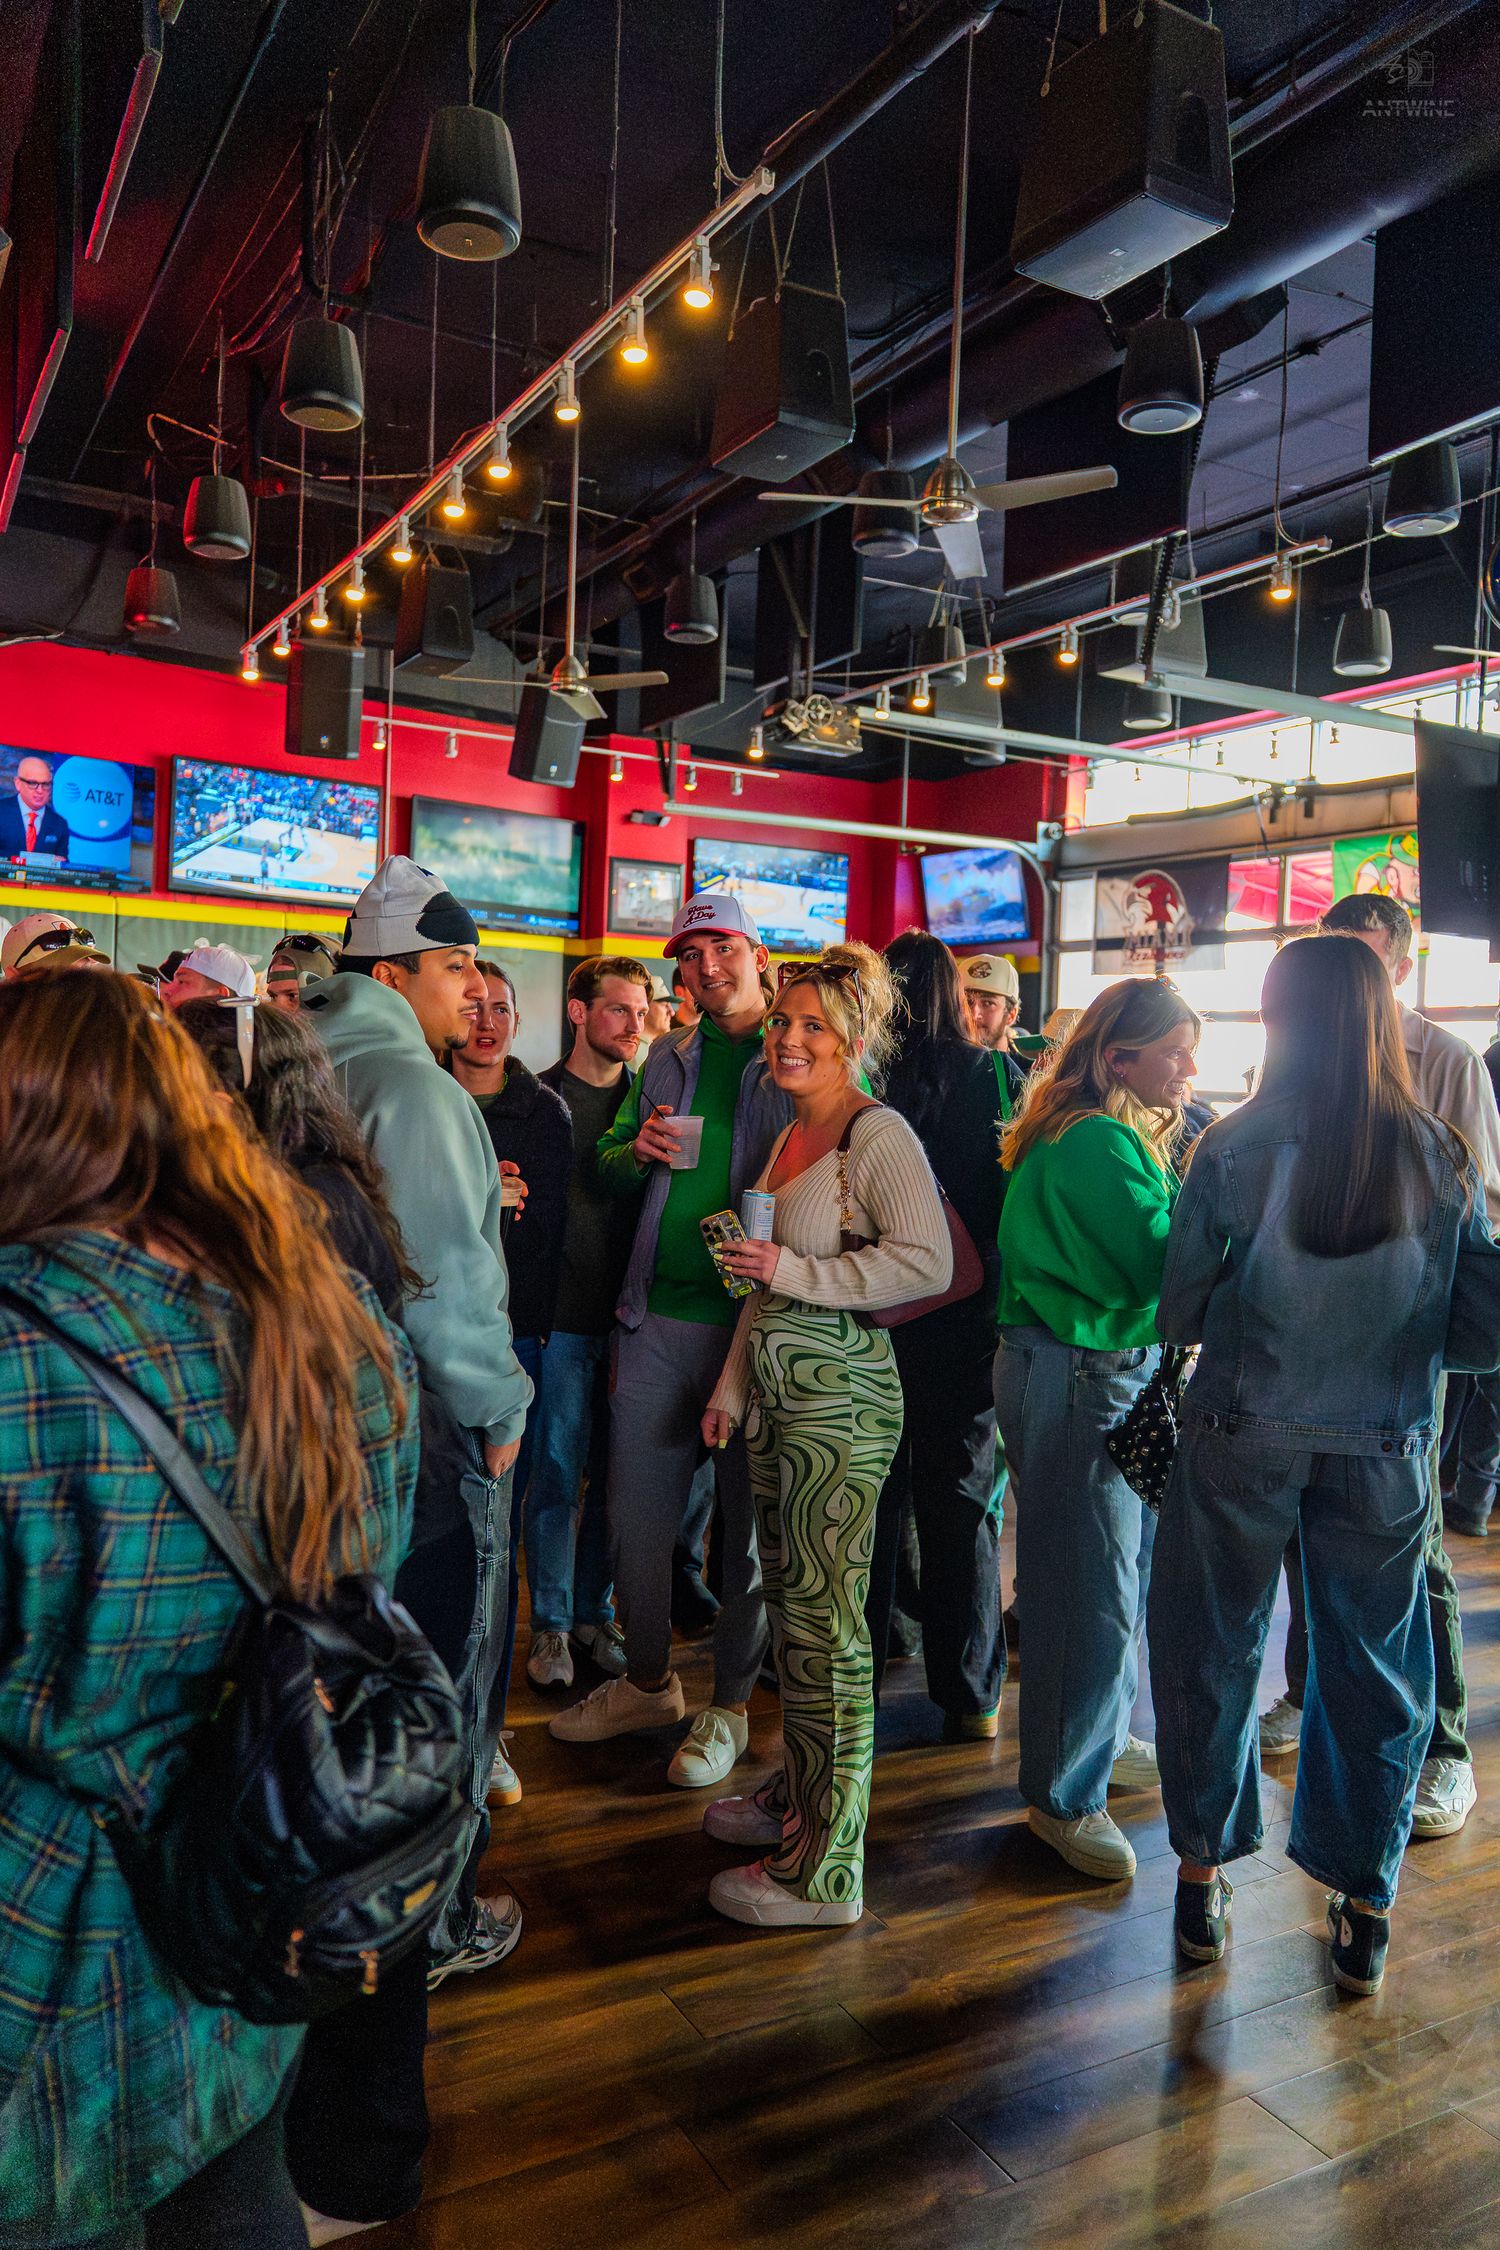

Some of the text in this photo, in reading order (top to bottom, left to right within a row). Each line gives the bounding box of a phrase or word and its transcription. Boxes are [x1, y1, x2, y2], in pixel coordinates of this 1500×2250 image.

[85, 788, 124, 806] AT&T
[688, 905, 713, 915] Have
[694, 911, 716, 919] Day
[1124, 930, 1191, 948] MIAMI
